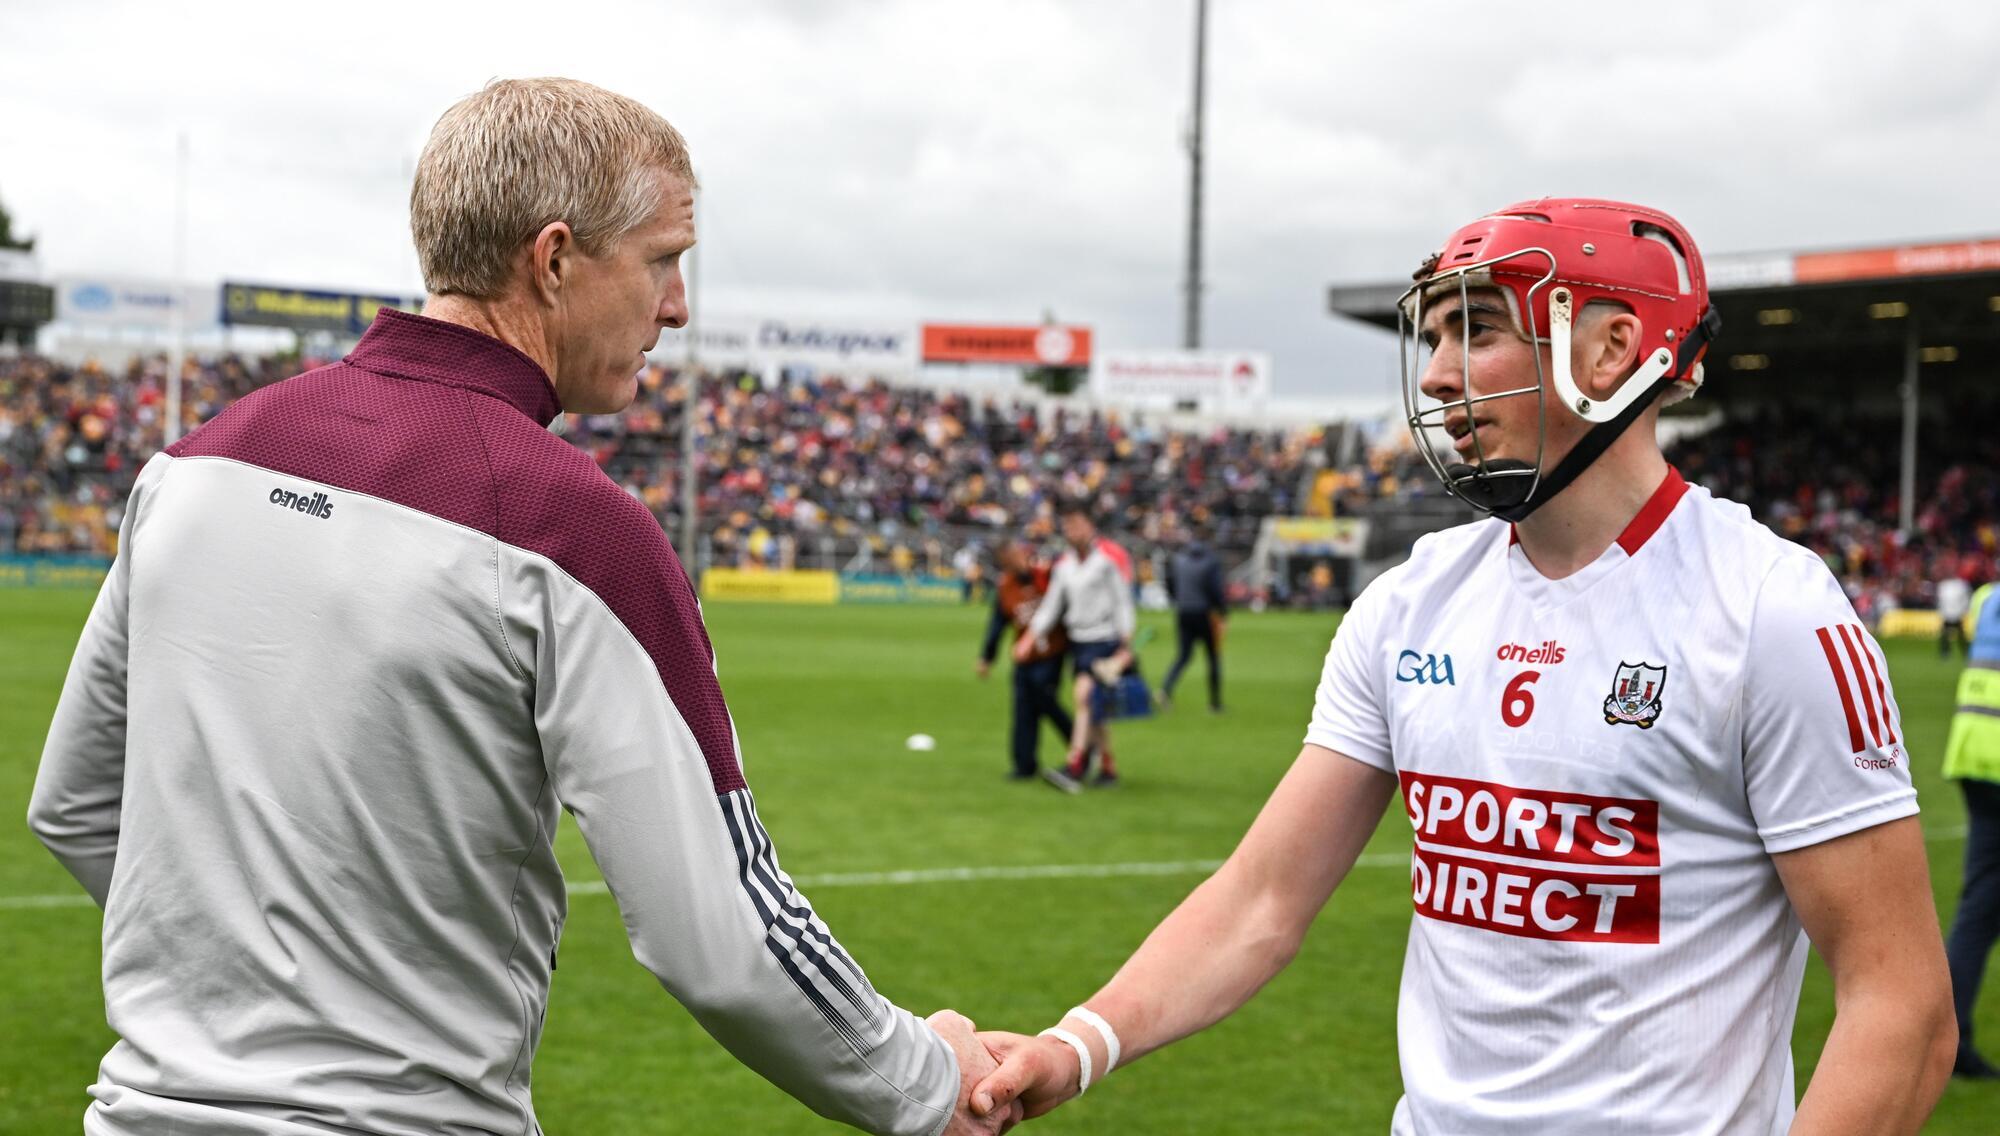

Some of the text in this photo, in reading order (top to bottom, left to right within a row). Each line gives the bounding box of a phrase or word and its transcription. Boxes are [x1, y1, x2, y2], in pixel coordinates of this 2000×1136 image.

[1396, 649, 1455, 686] GAA
[1501, 670, 1541, 728] 6
[1409, 781, 1636, 857] SPORTS
[1413, 854, 1637, 934] DIRECT
